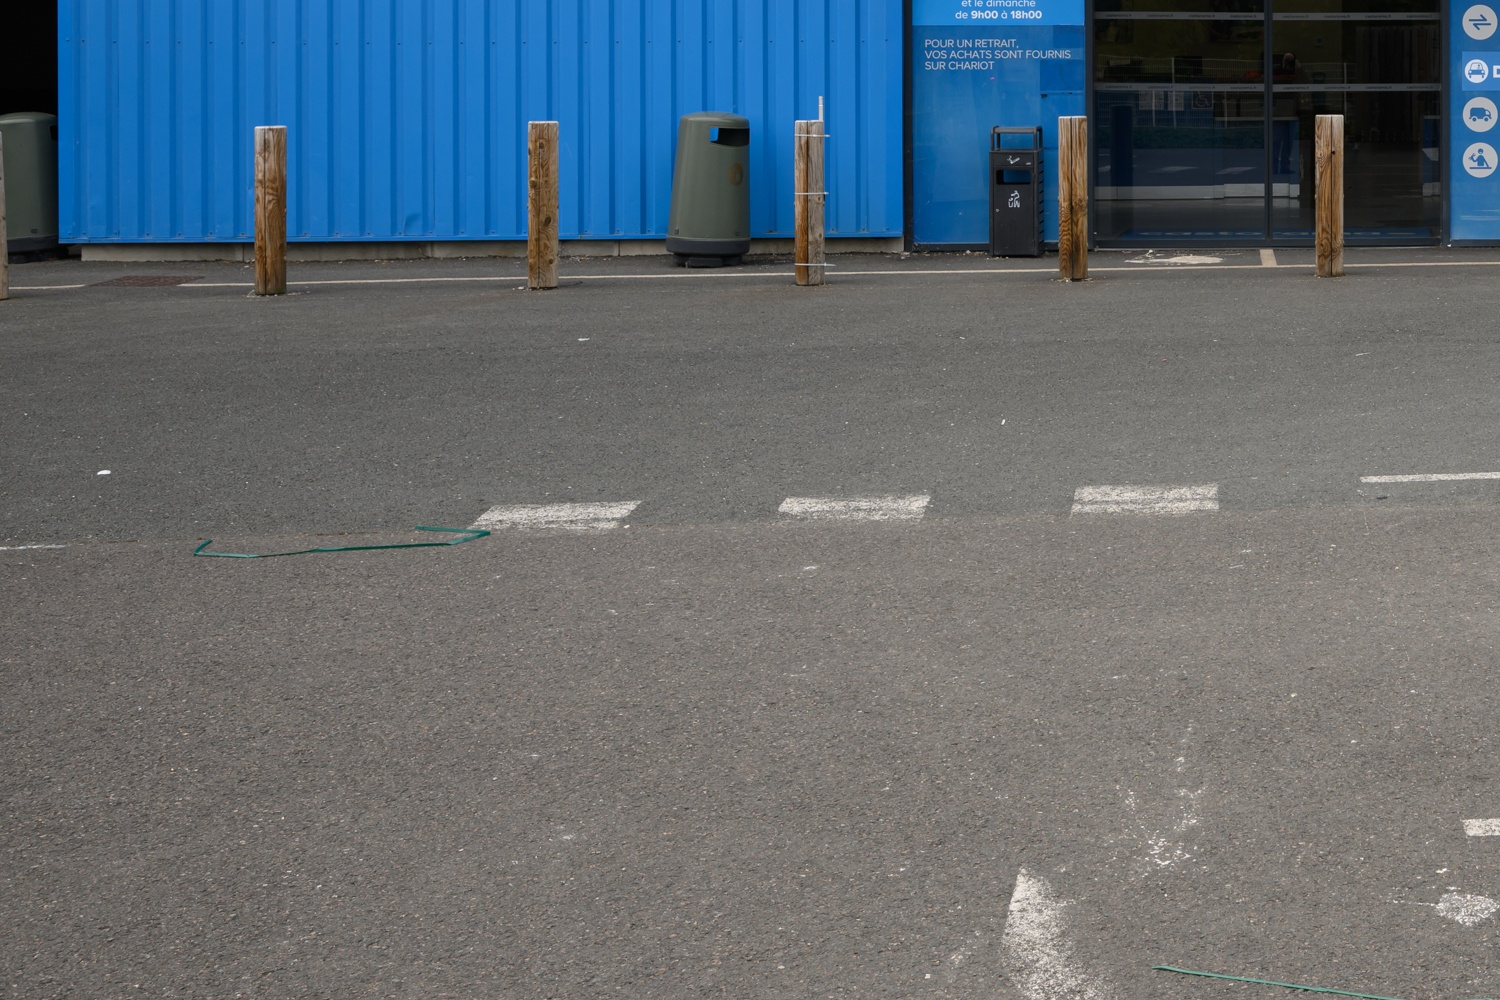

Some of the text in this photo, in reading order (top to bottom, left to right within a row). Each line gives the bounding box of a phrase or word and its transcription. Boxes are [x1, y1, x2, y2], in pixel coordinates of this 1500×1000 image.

[955, 10, 1043, 20] de 9h00 à 18h00
[924, 39, 1019, 49] POUR UN RETRAIT,
[924, 49, 1072, 59] VOS ACHATS SONT FOURNIS
[924, 60, 995, 70] SUR CHARIOT
